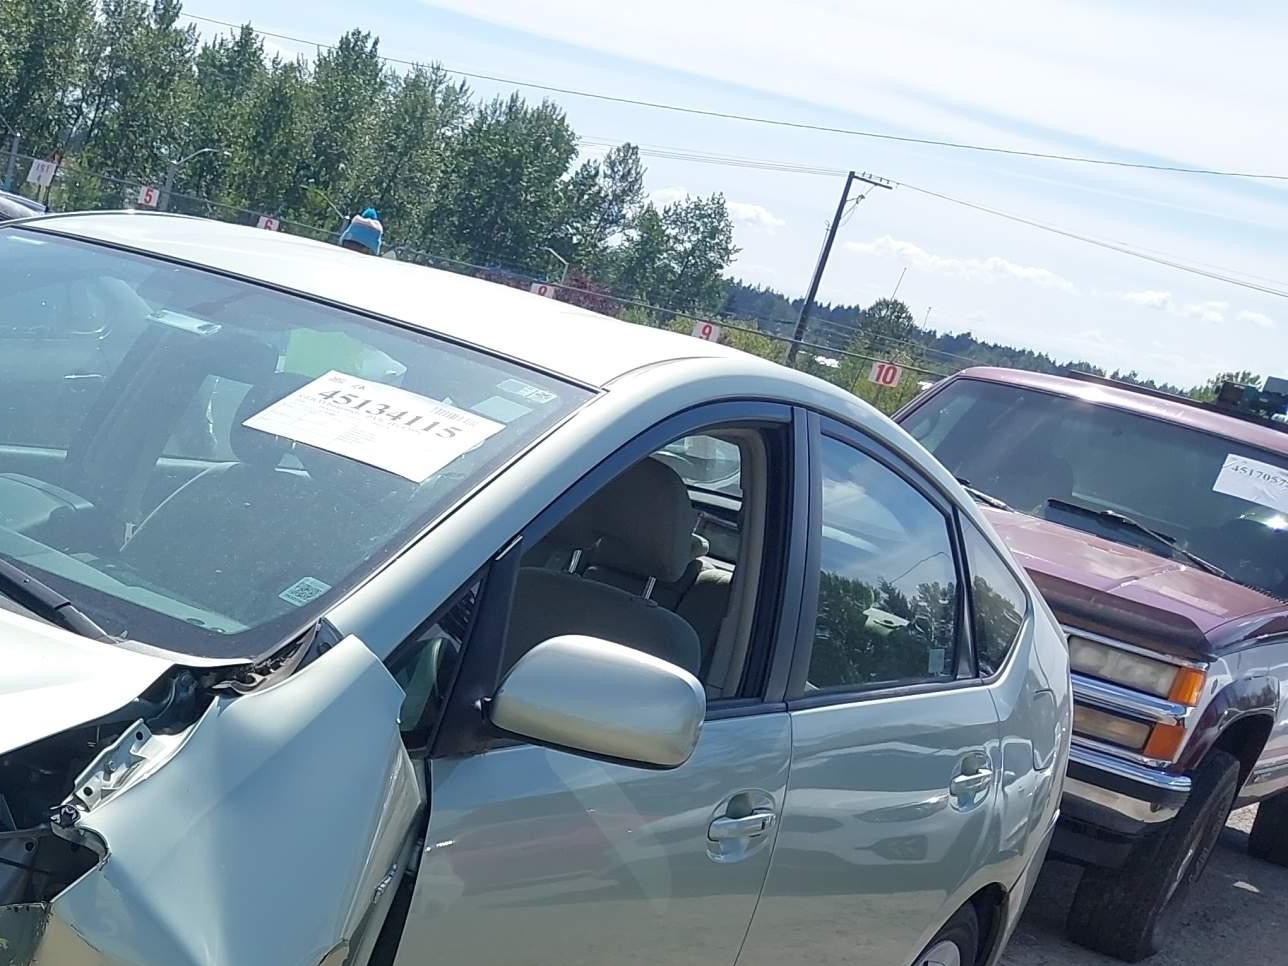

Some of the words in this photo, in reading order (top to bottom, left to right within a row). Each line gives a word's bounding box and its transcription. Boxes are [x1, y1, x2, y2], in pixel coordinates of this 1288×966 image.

[144, 187, 155, 204] 5
[700, 324, 713, 340] 9
[875, 364, 898, 385] 10
[316, 388, 463, 440] 45134115
[1231, 464, 1288, 487] 4517057
